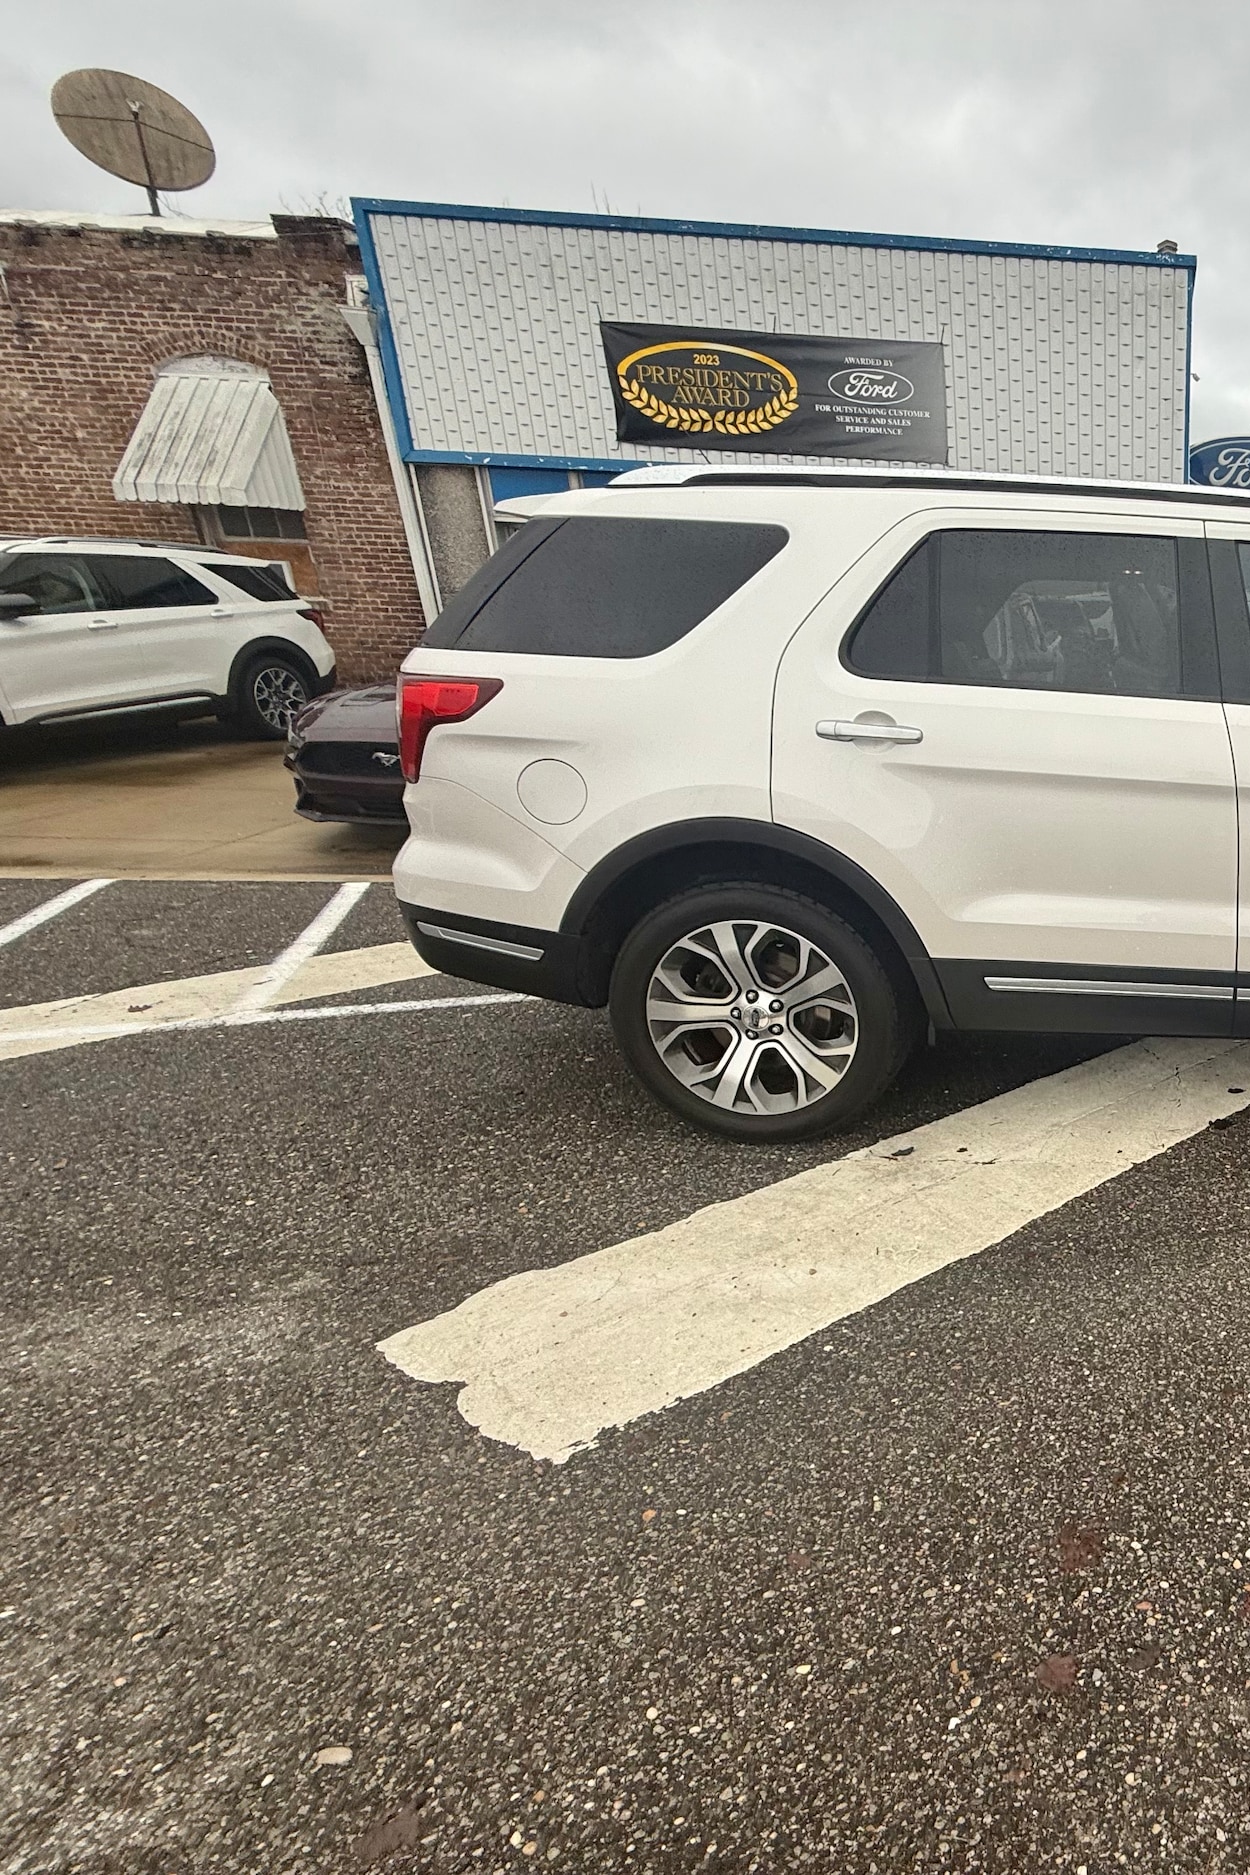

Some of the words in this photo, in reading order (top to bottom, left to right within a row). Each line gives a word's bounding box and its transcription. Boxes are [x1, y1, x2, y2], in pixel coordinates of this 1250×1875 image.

[693, 354, 720, 366] 2023
[844, 357, 882, 366] AWARDED
[883, 359, 894, 367] BY
[636, 364, 783, 392] PRESIDENT'S
[844, 372, 898, 398] Ford
[671, 385, 750, 408] AWARD
[815, 404, 831, 412] FOR
[833, 405, 887, 416] OUTSTANDING
[888, 408, 931, 418] CUSTOMER
[836, 415, 869, 424] SERVICE
[870, 417, 887, 425] AND
[887, 418, 911, 426] SALES
[845, 425, 903, 435] PERFORMANCE
